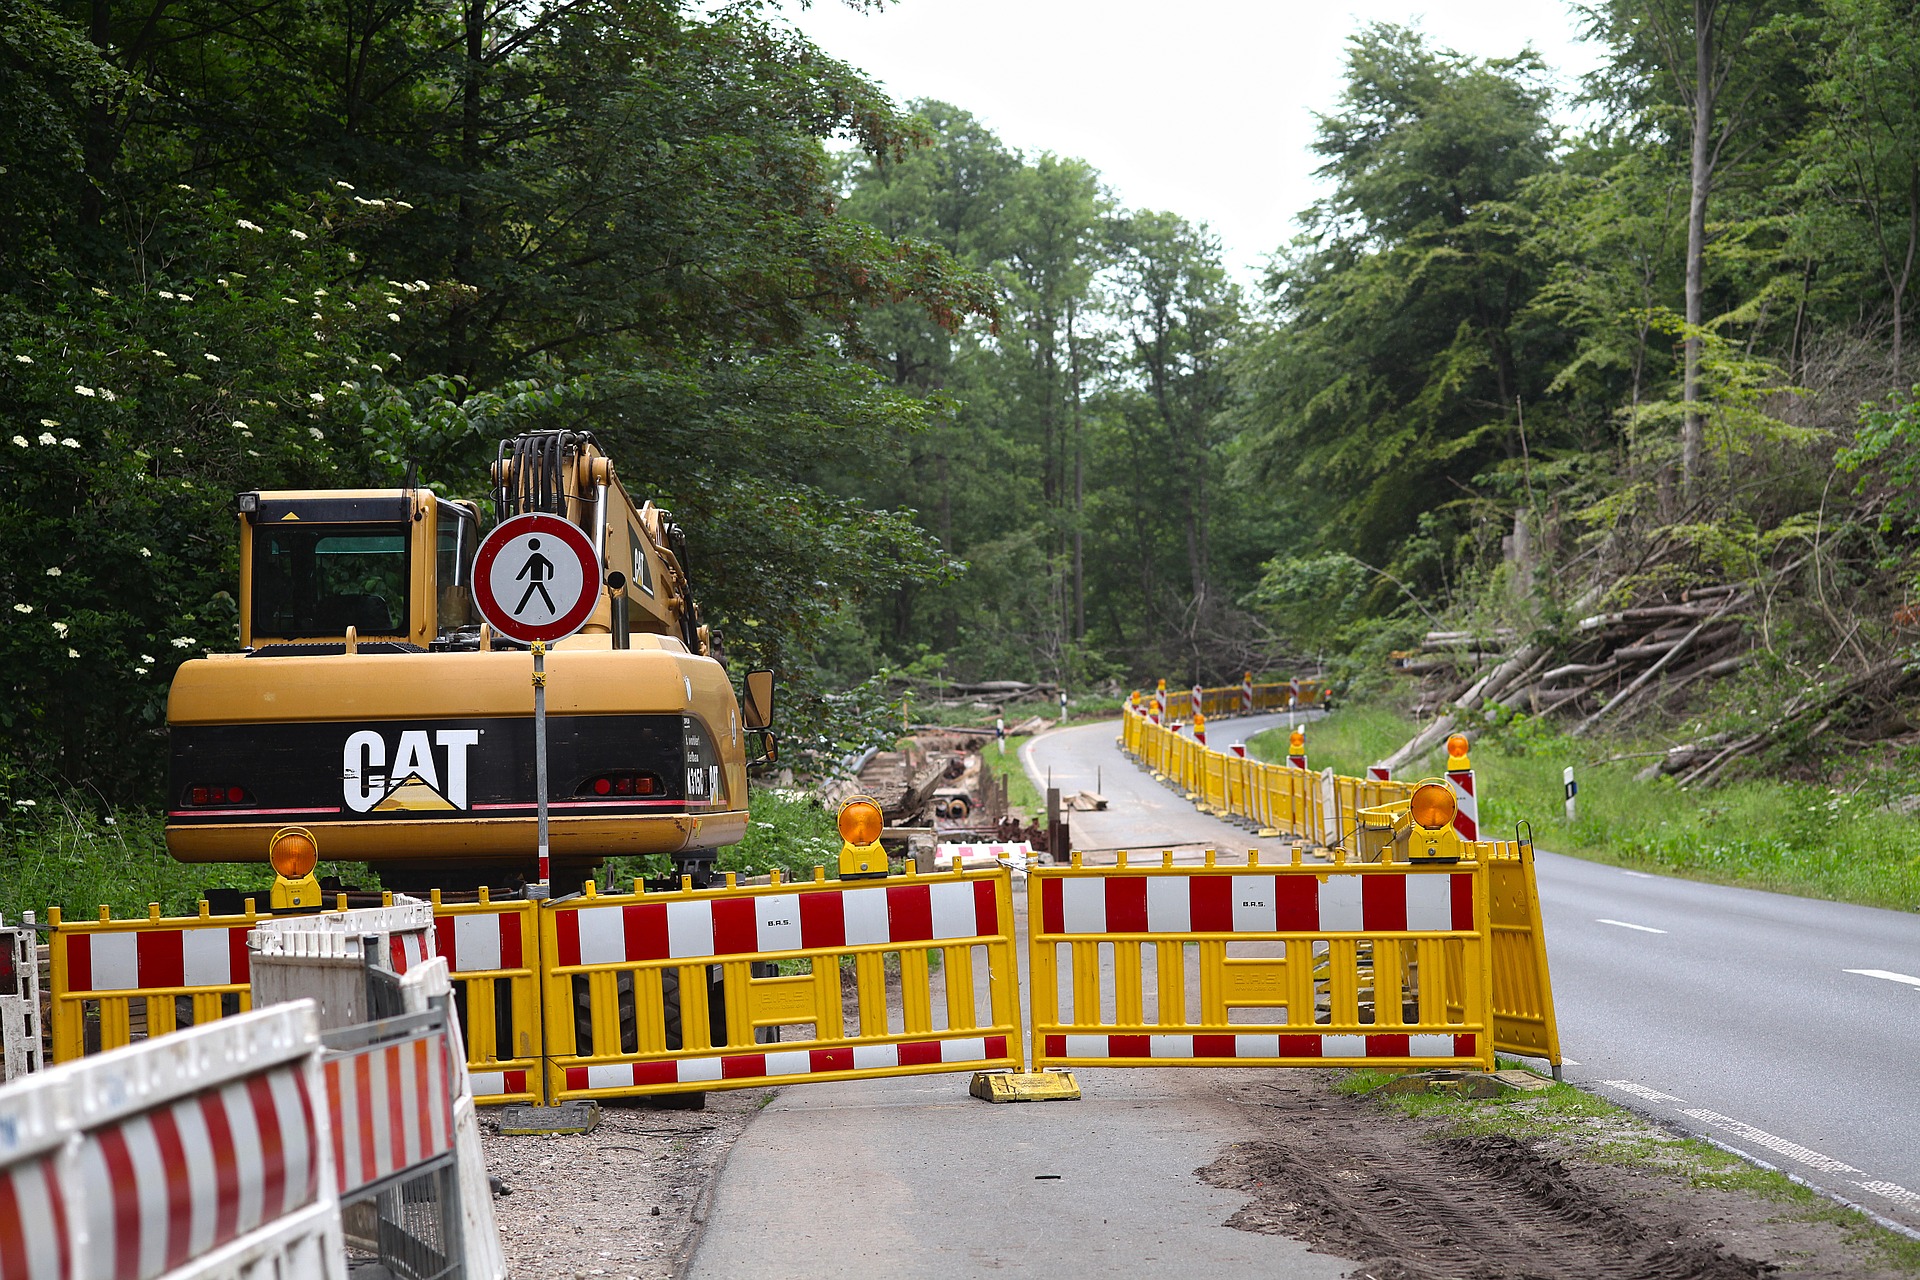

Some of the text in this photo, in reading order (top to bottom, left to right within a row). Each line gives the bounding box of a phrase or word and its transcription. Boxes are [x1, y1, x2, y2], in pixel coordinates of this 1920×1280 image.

[634, 548, 644, 586] CAT
[343, 729, 479, 813] CAT
[709, 765, 719, 805] CAT
